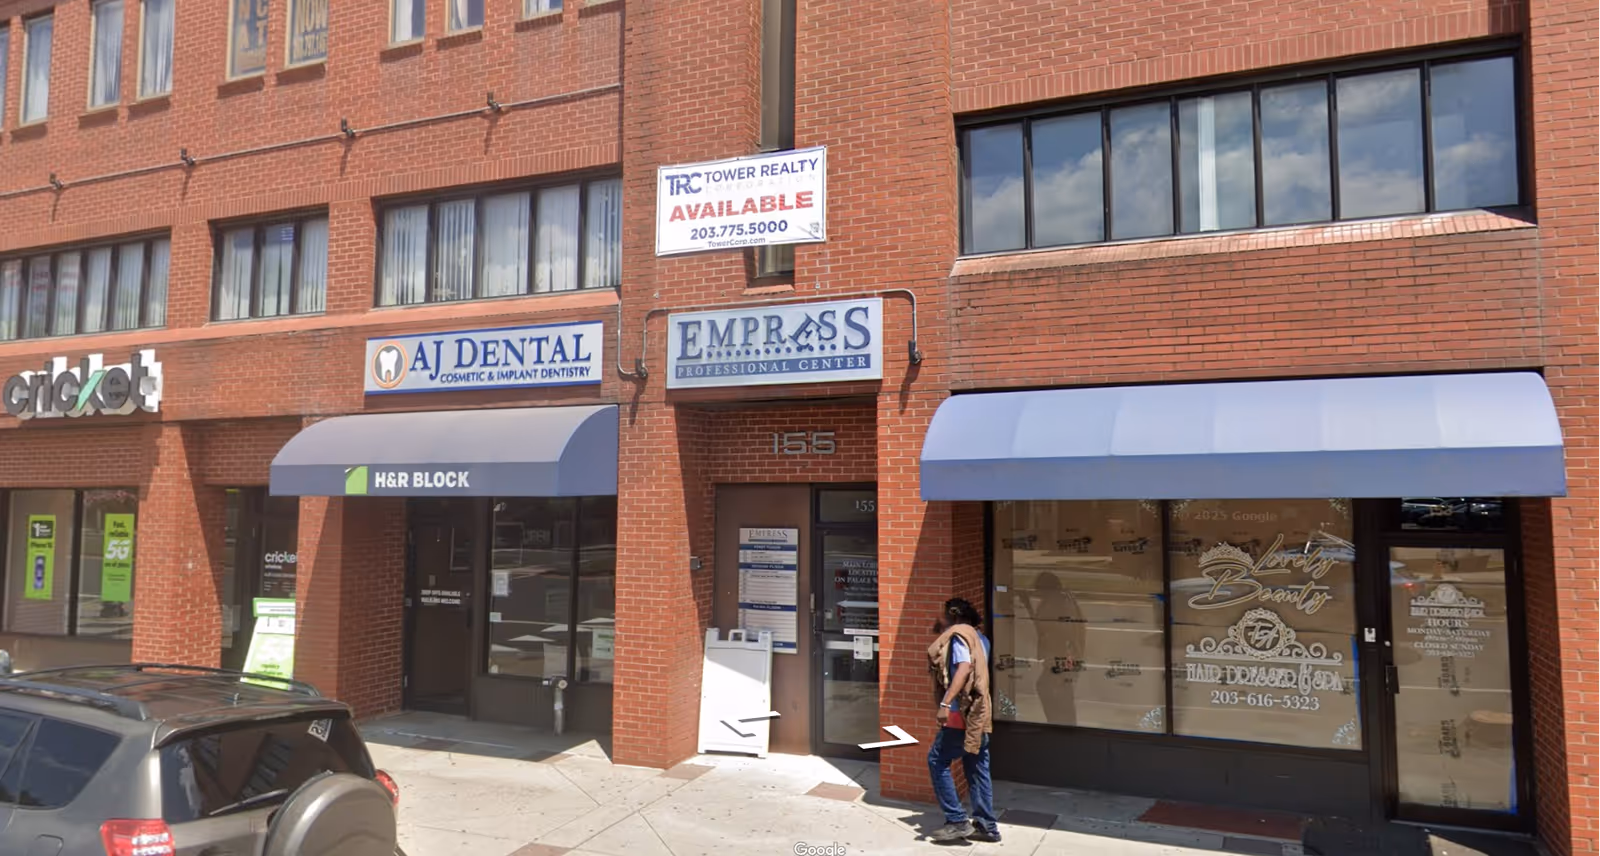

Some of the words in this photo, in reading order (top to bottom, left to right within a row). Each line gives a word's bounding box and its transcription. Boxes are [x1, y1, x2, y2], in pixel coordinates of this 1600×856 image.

[665, 172, 702, 196] TRC
[704, 166, 756, 183] TOWER
[760, 158, 818, 177] REALTY
[669, 191, 814, 222] AVAILABLE
[690, 220, 788, 240] 203.775.5000
[708, 237, 766, 248] TowerCorp.com
[676, 306, 872, 361] EMPRESS
[409, 340, 444, 381] AJ
[453, 333, 592, 369] DENTAL
[677, 360, 790, 378] PROFESSIONAL
[798, 356, 867, 371] CENTER
[3, 350, 161, 418] cricket
[440, 371, 485, 384] COSMETIC
[487, 371, 494, 381] &
[497, 369, 539, 380] IMPLANT
[541, 366, 591, 378] DENTISTRY
[772, 431, 836, 455] 155
[375, 471, 409, 488] H&R
[412, 471, 470, 488] BLOCK
[855, 500, 875, 512] 155
[105, 539, 130, 560] 5G
[1251, 533, 1339, 579] Lovely
[1188, 563, 1333, 615] Beauty
[1427, 618, 1469, 628] HOURS
[1186, 663, 1222, 684] HAIR
[1225, 665, 1297, 688] DRESSER
[1312, 670, 1344, 691] SPA
[1210, 690, 1320, 711] 203-616-5323
